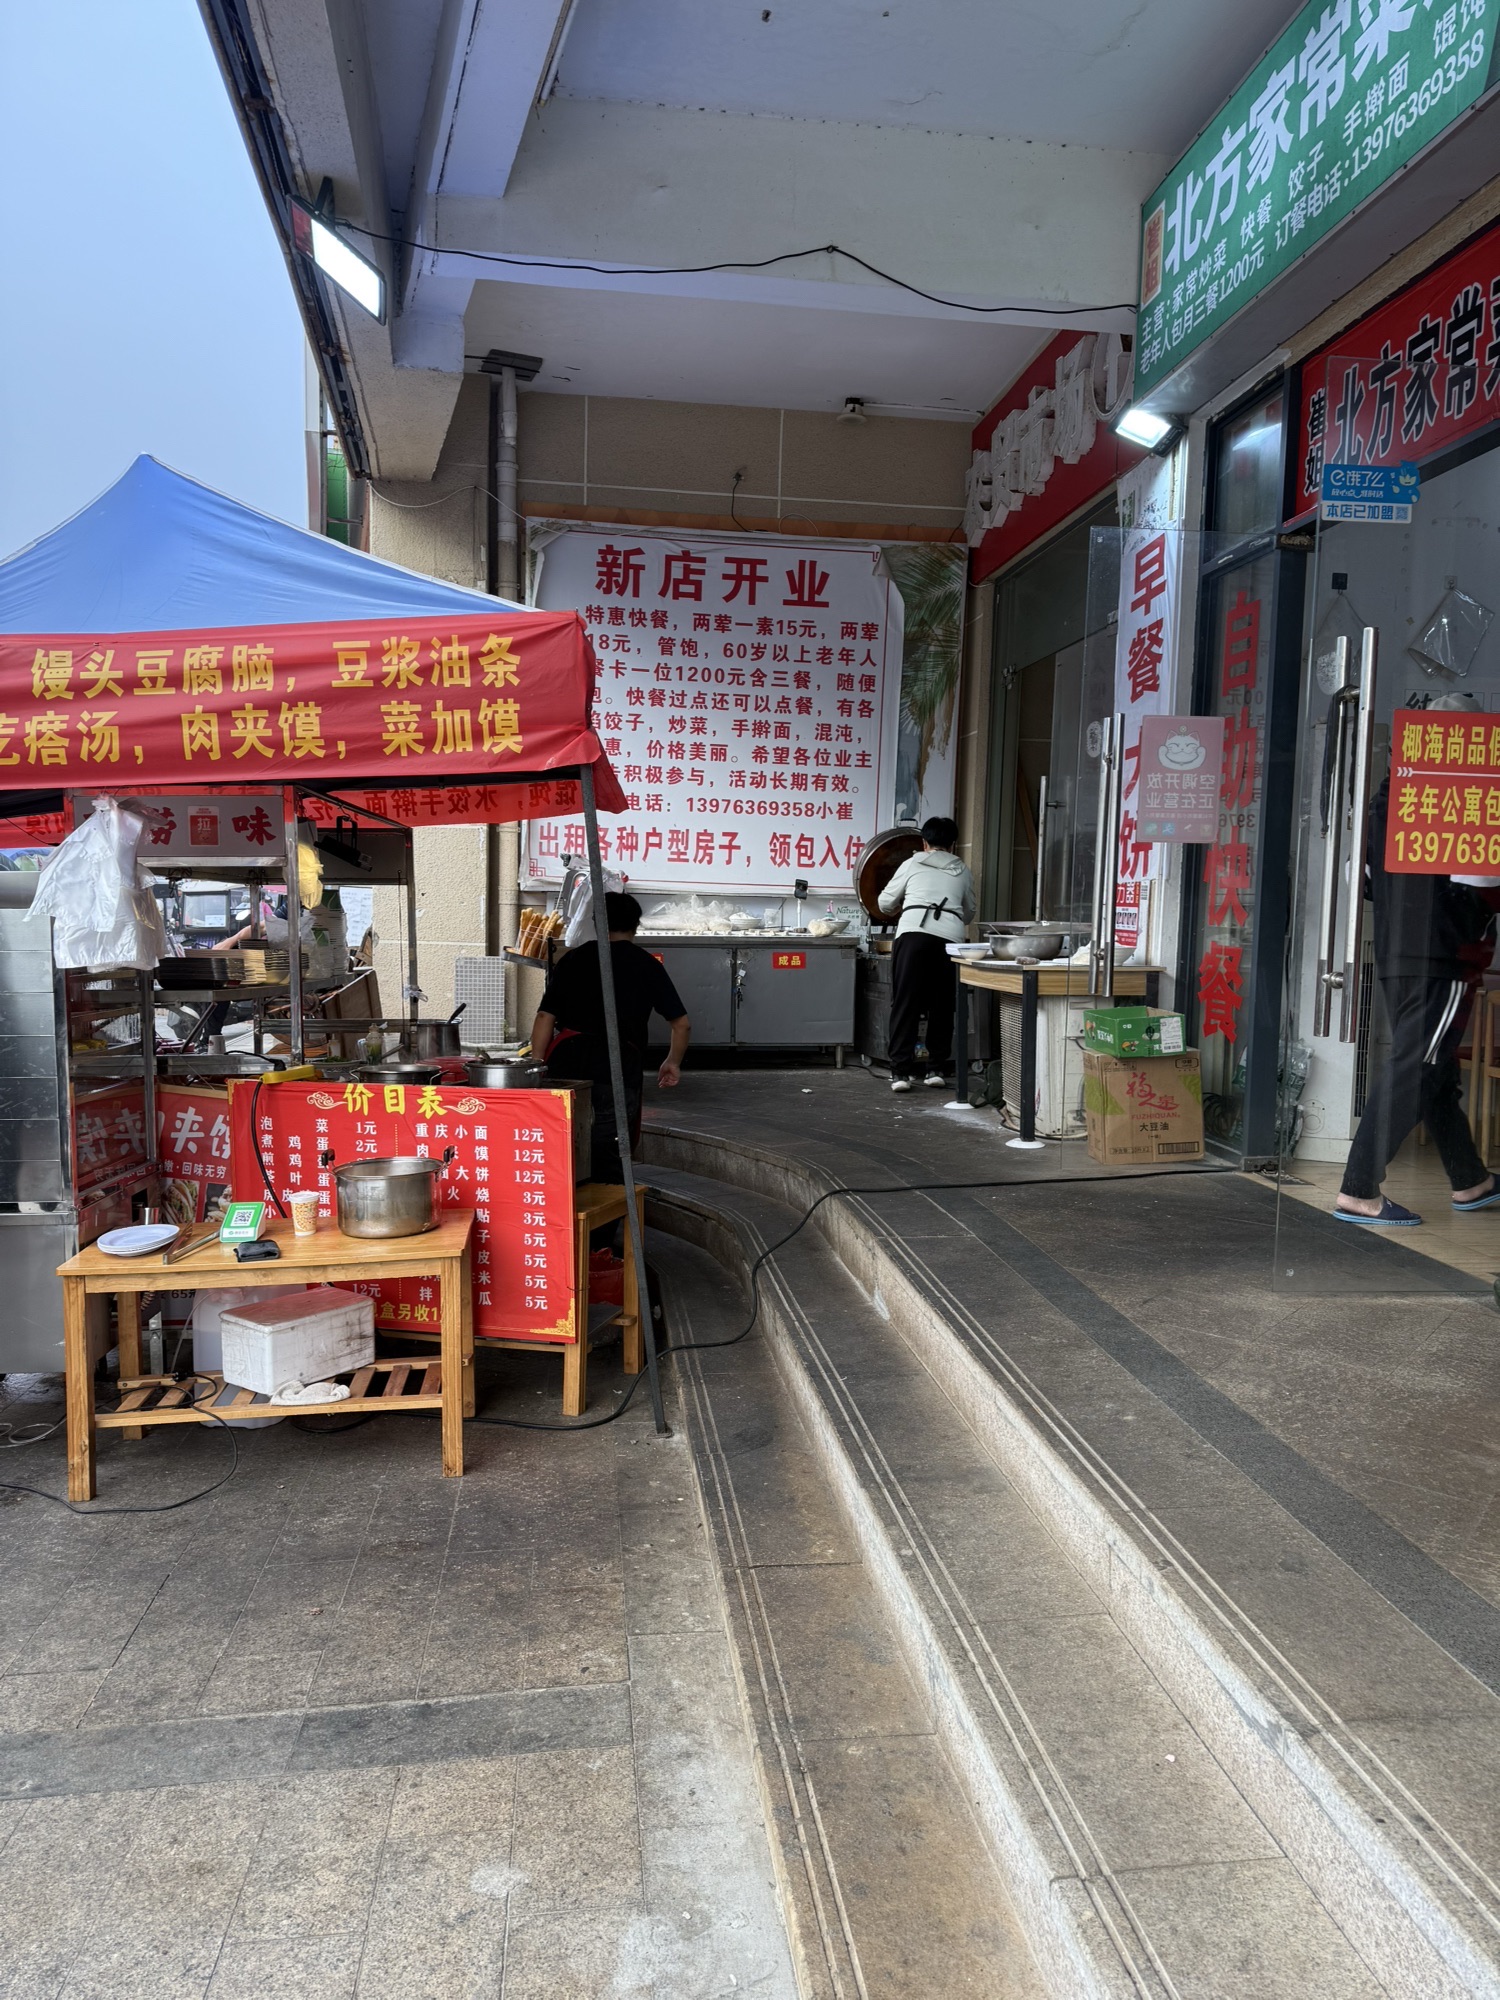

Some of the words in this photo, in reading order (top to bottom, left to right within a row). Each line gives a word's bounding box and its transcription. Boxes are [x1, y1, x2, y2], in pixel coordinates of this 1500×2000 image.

[1239, 192, 1273, 249] 快餐
[1287, 140, 1324, 202] 饺子
[1342, 51, 1410, 146] 手擀面
[1326, 503, 1394, 521] 本店已加盟
[595, 544, 830, 608] 新店开业
[585, 604, 880, 642] 特惠快餐，两荤一素15元，两荤
[31, 632, 522, 700] 馒头豆腐脑，豆浆油条
[1397, 782, 1500, 828] 老年公寓包
[1394, 831, 1500, 866] 1397636
[778, 956, 801, 967] 成品
[343, 1083, 448, 1119] 价目表
[260, 1116, 329, 1134] 泡菜
[356, 1121, 377, 1136] 1元
[415, 1123, 488, 1141] 重庆小面
[513, 1128, 545, 1143] 12元
[1139, 1122, 1170, 1132] 大豆油
[261, 1134, 330, 1151] 煮鸡蛋
[355, 1139, 378, 1154] 2元
[513, 1149, 546, 1164] 12元
[514, 1170, 546, 1185] 12元
[263, 1187, 331, 1205] 虎皮蛋
[523, 1190, 546, 1206] 3元
[476, 1208, 490, 1224] 贴
[523, 1211, 547, 1227] 3元
[476, 1229, 491, 1245] 子
[524, 1232, 547, 1248] 5元
[477, 1250, 491, 1265] 皮
[524, 1252, 547, 1269] 5元
[352, 1283, 382, 1298] 12元
[525, 1273, 548, 1290] 5元
[373, 1301, 444, 1322] 盒另收1
[525, 1294, 548, 1310] 5元
